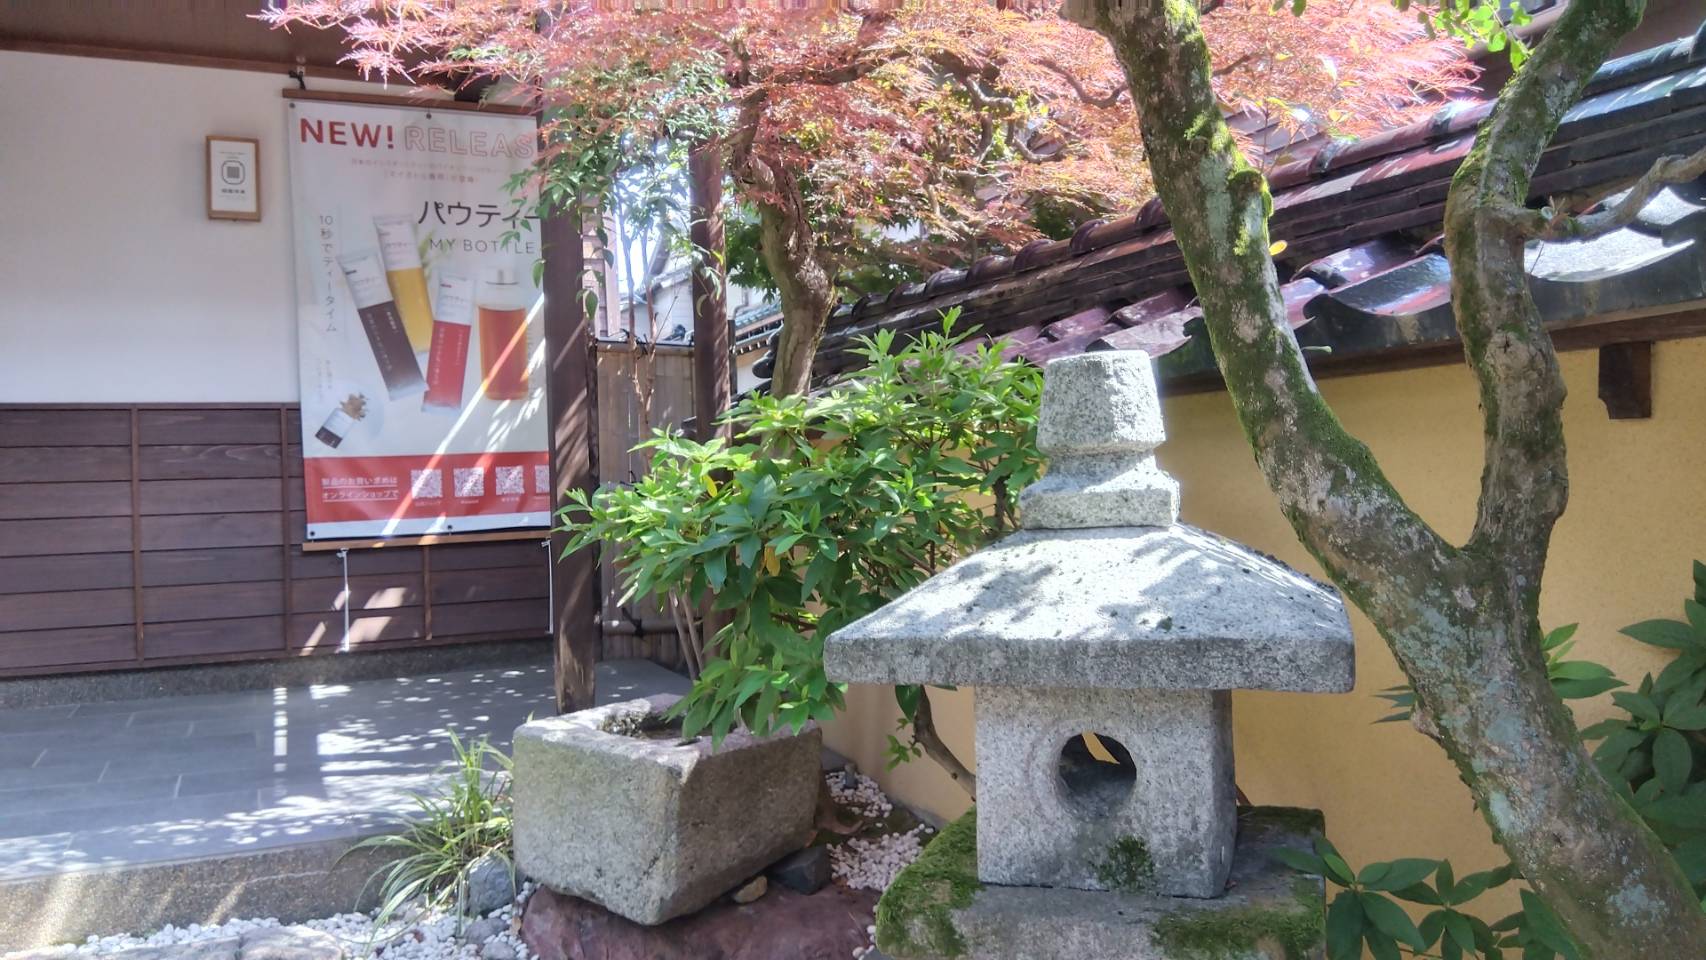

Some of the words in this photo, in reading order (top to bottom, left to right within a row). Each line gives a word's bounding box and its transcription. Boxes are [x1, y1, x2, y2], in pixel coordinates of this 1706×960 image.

[300, 118, 394, 149] NEW!
[417, 201, 540, 229] パウティー
[429, 239, 456, 250] MY
[319, 215, 337, 332] 10秒でティータイム
